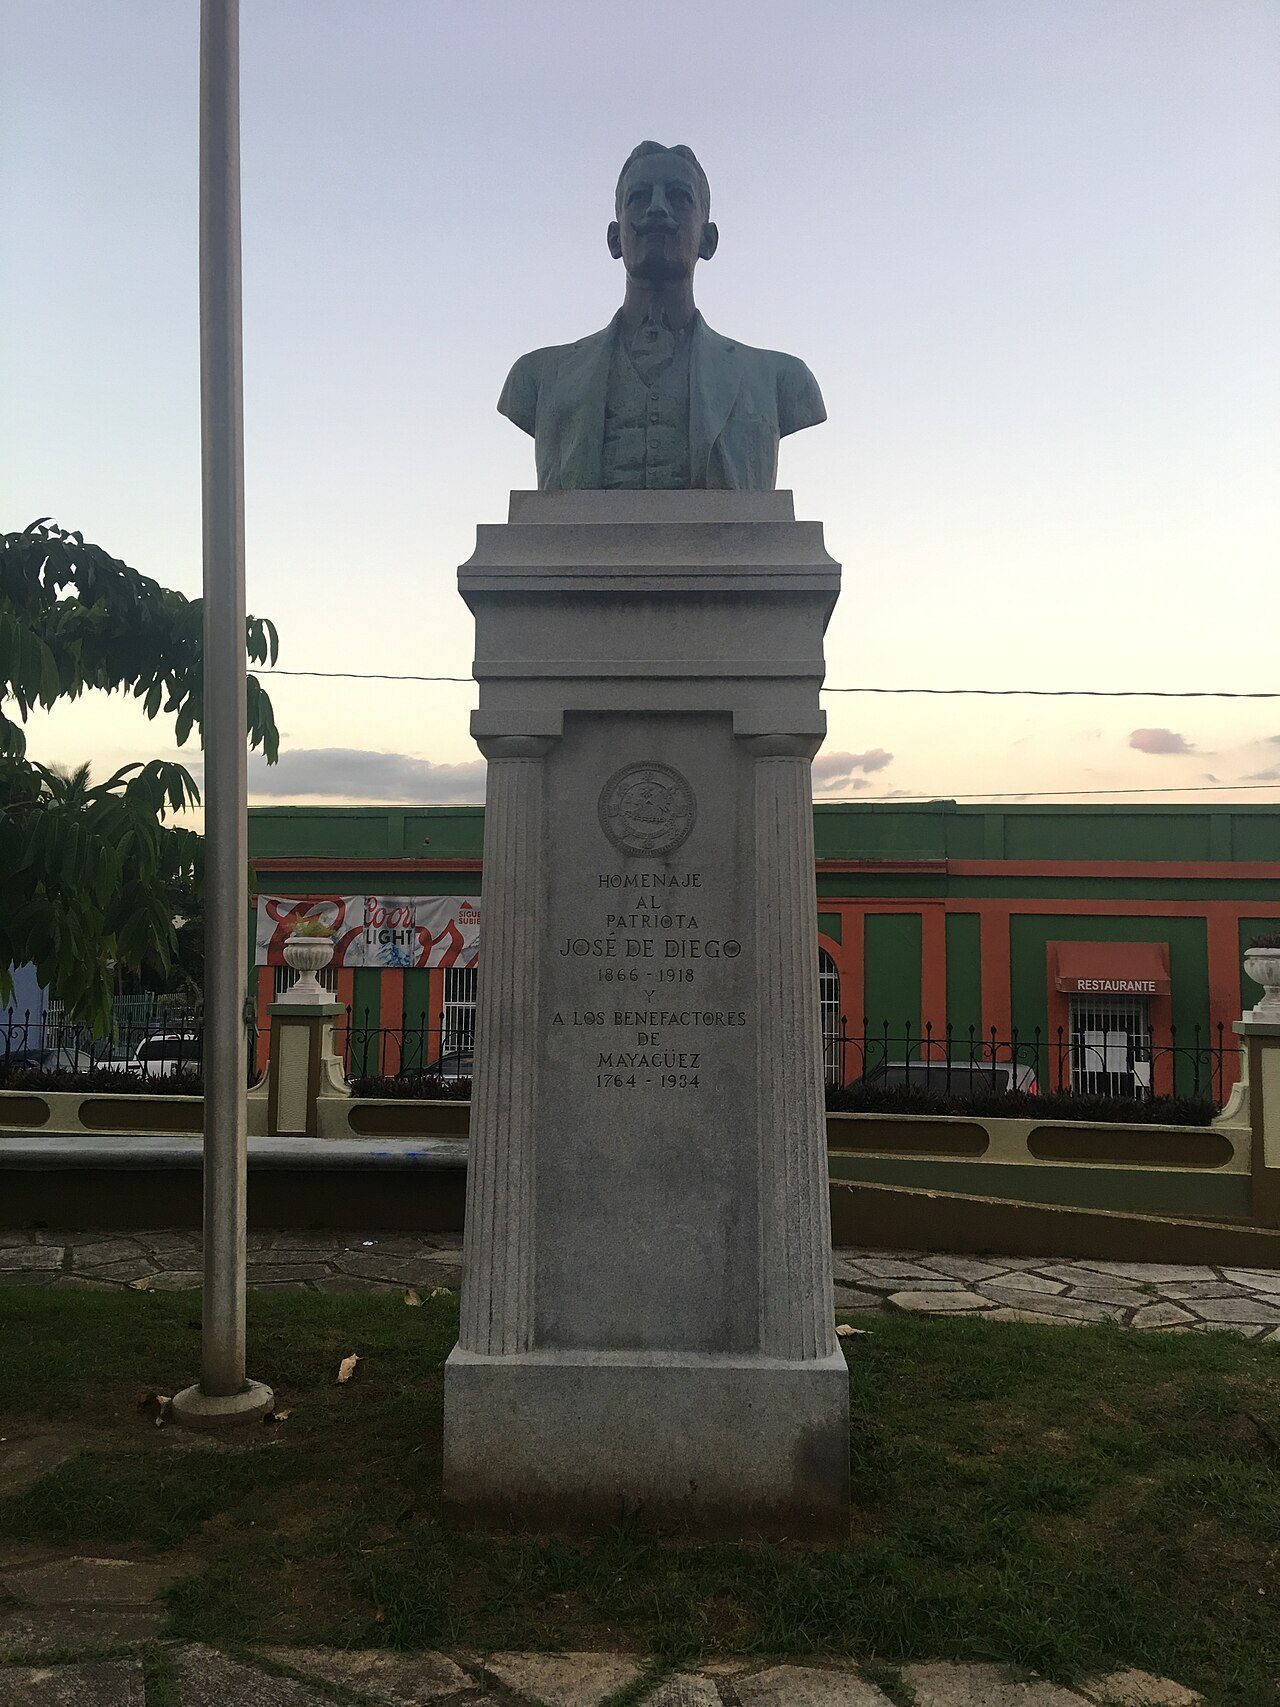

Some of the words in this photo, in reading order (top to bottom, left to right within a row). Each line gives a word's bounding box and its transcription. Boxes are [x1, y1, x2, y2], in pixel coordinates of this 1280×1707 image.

[598, 873, 702, 889] HOMENAJE
[635, 895, 661, 909] AL
[606, 914, 699, 929] PATRIOTA
[366, 929, 413, 945] LIGHT
[559, 932, 617, 957] JOSÉ
[625, 939, 655, 957] DE
[664, 939, 742, 958] DIEGO
[599, 968, 639, 982] 1866
[659, 968, 695, 982] 1918
[1077, 979, 1156, 992] RESTAURANTE
[644, 989, 656, 1003] Y
[551, 1012, 566, 1026] A
[573, 1011, 606, 1026] LOS
[613, 1011, 747, 1027] BENEFACTORES
[637, 1032, 661, 1046] DE
[597, 1048, 701, 1069] MAYAGÜEZ
[597, 1074, 637, 1088] 1764
[661, 1074, 701, 1088] 1934
